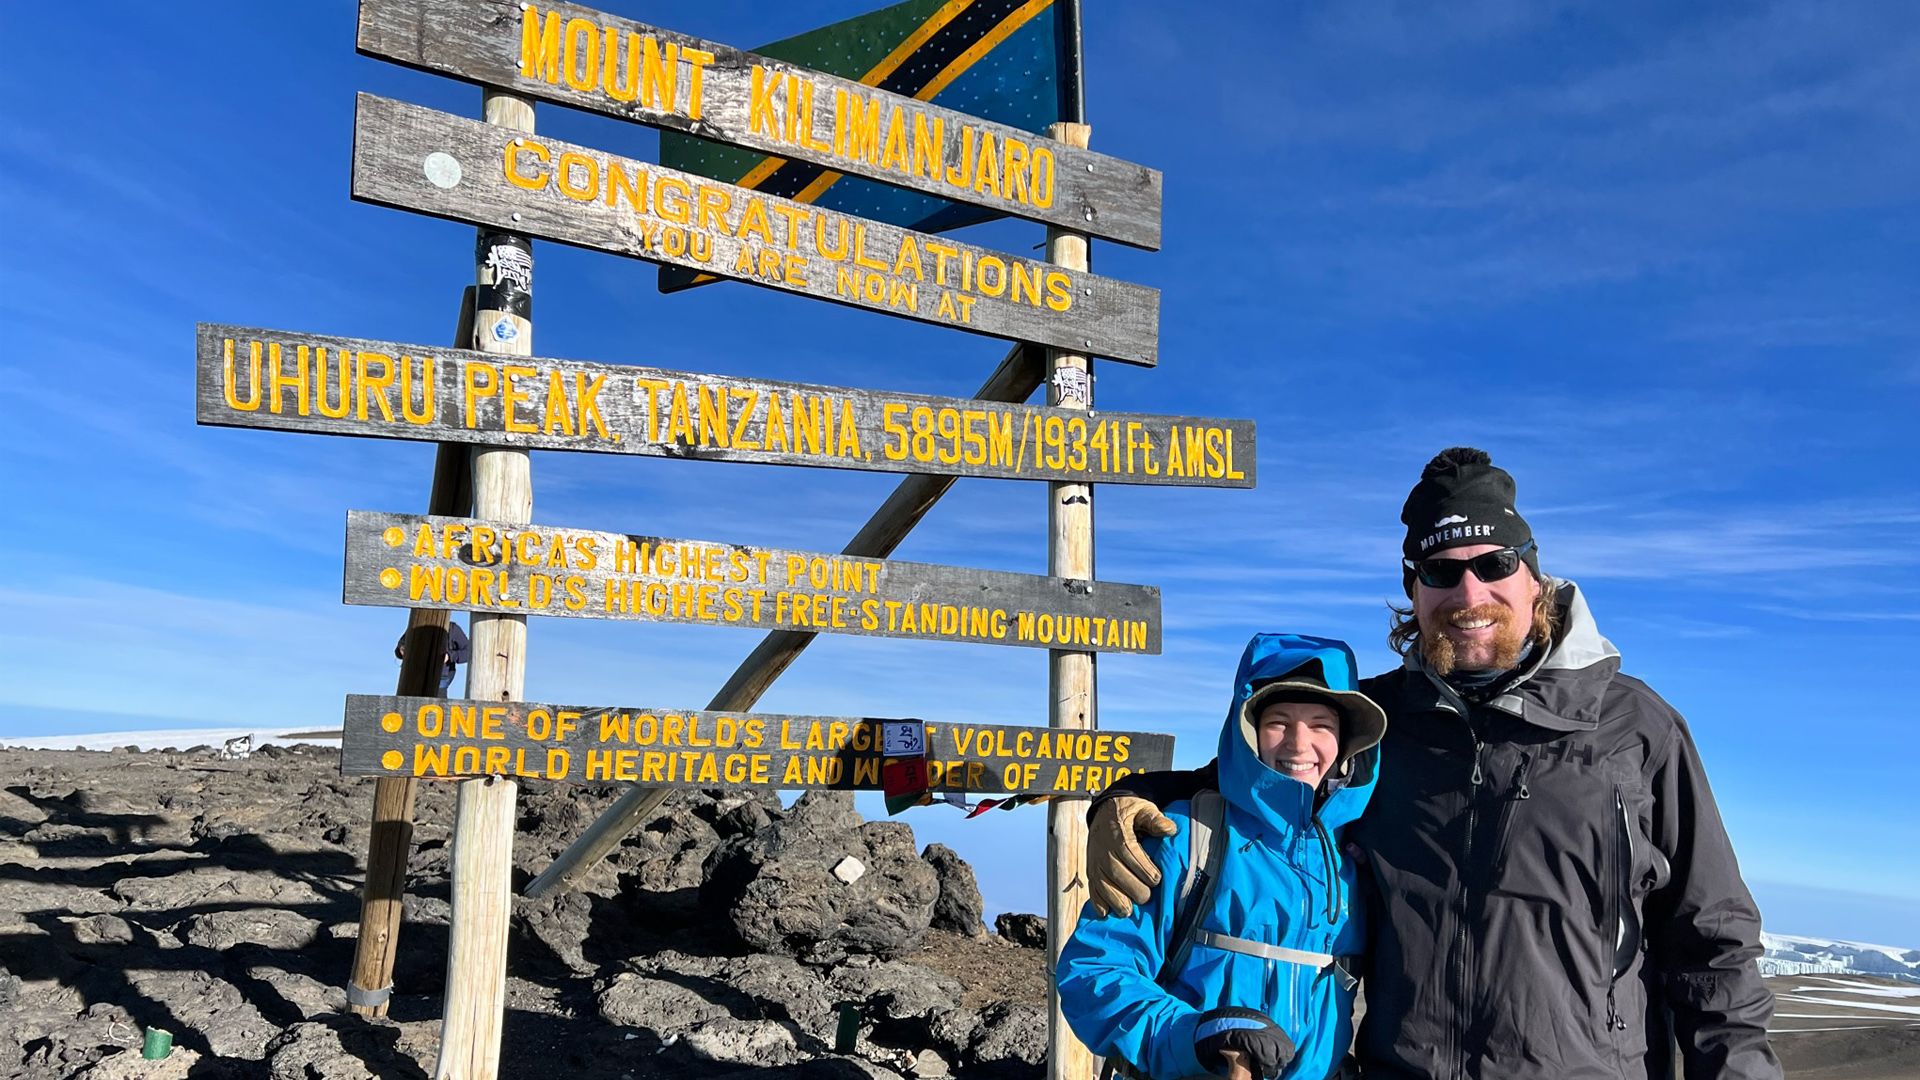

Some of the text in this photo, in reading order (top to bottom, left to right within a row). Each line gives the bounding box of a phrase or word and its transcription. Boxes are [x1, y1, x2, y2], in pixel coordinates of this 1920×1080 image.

[521, 4, 1056, 210] MOUNT KILIMANJARO
[504, 138, 1073, 313] CONGRATULATIONS
[639, 218, 977, 324] YOU ARE NOW AT
[223, 338, 436, 426] UHURU
[464, 361, 622, 444] PEAK,
[637, 378, 873, 462] TANZANIA,
[1166, 425, 1246, 481] AMSL
[614, 540, 772, 584] HIGHEST
[786, 553, 884, 595] POINT
[1420, 525, 1494, 551] MOVEMBER
[604, 577, 766, 624] HIGHEST
[1016, 611, 1149, 651] MOUNTAIN
[412, 743, 571, 781] WORLD
[585, 748, 774, 785] HERITAGE
[783, 753, 845, 787] AND
[852, 756, 985, 789] WDER
[1003, 761, 1042, 791] OF
[416, 704, 507, 740] ONE
[526, 709, 582, 743] OF
[598, 712, 767, 749] WORLD'S
[952, 727, 1132, 764] VOLCANOES
[1534, 736, 1593, 767] HH
